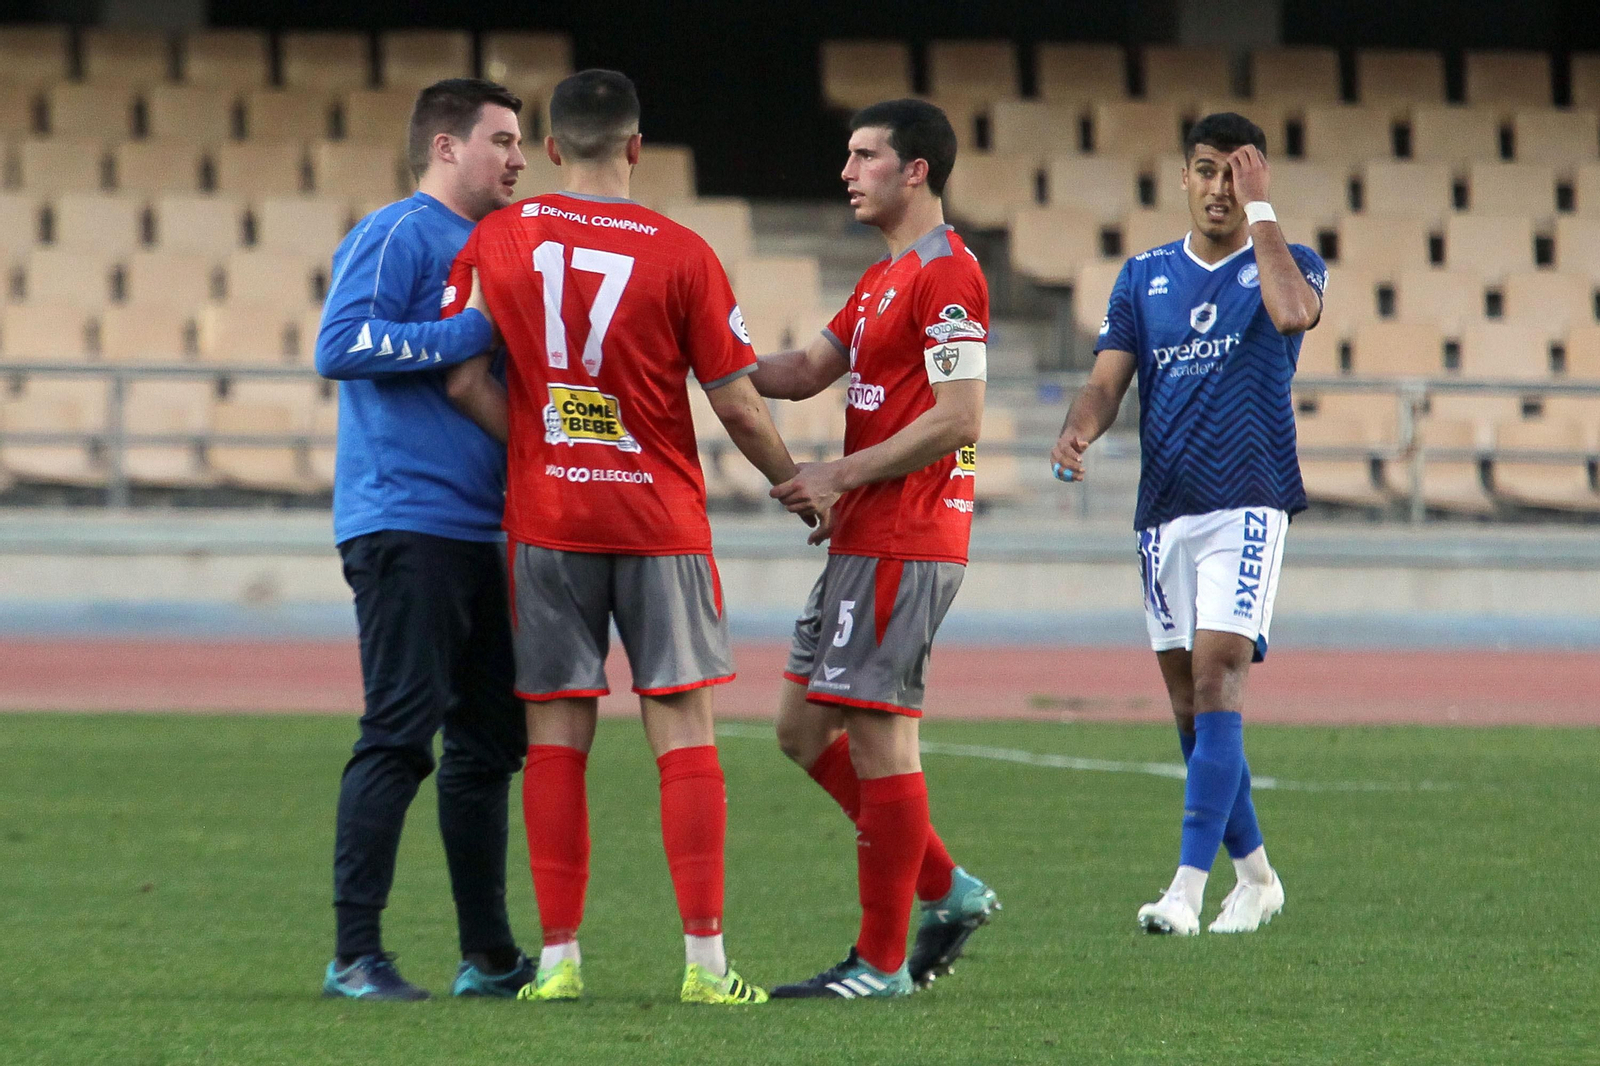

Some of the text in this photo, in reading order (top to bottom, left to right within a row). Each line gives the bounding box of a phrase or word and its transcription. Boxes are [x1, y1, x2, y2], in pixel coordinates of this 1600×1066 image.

[541, 205, 658, 236] DENTAL COMPANY
[533, 240, 635, 378] 17
[1152, 332, 1241, 370] preforti
[562, 400, 615, 419] COME
[569, 416, 618, 435] BEBE
[591, 468, 654, 484] ELECCIÓN
[1235, 510, 1268, 601] XEREZ
[832, 600, 856, 648] 5
